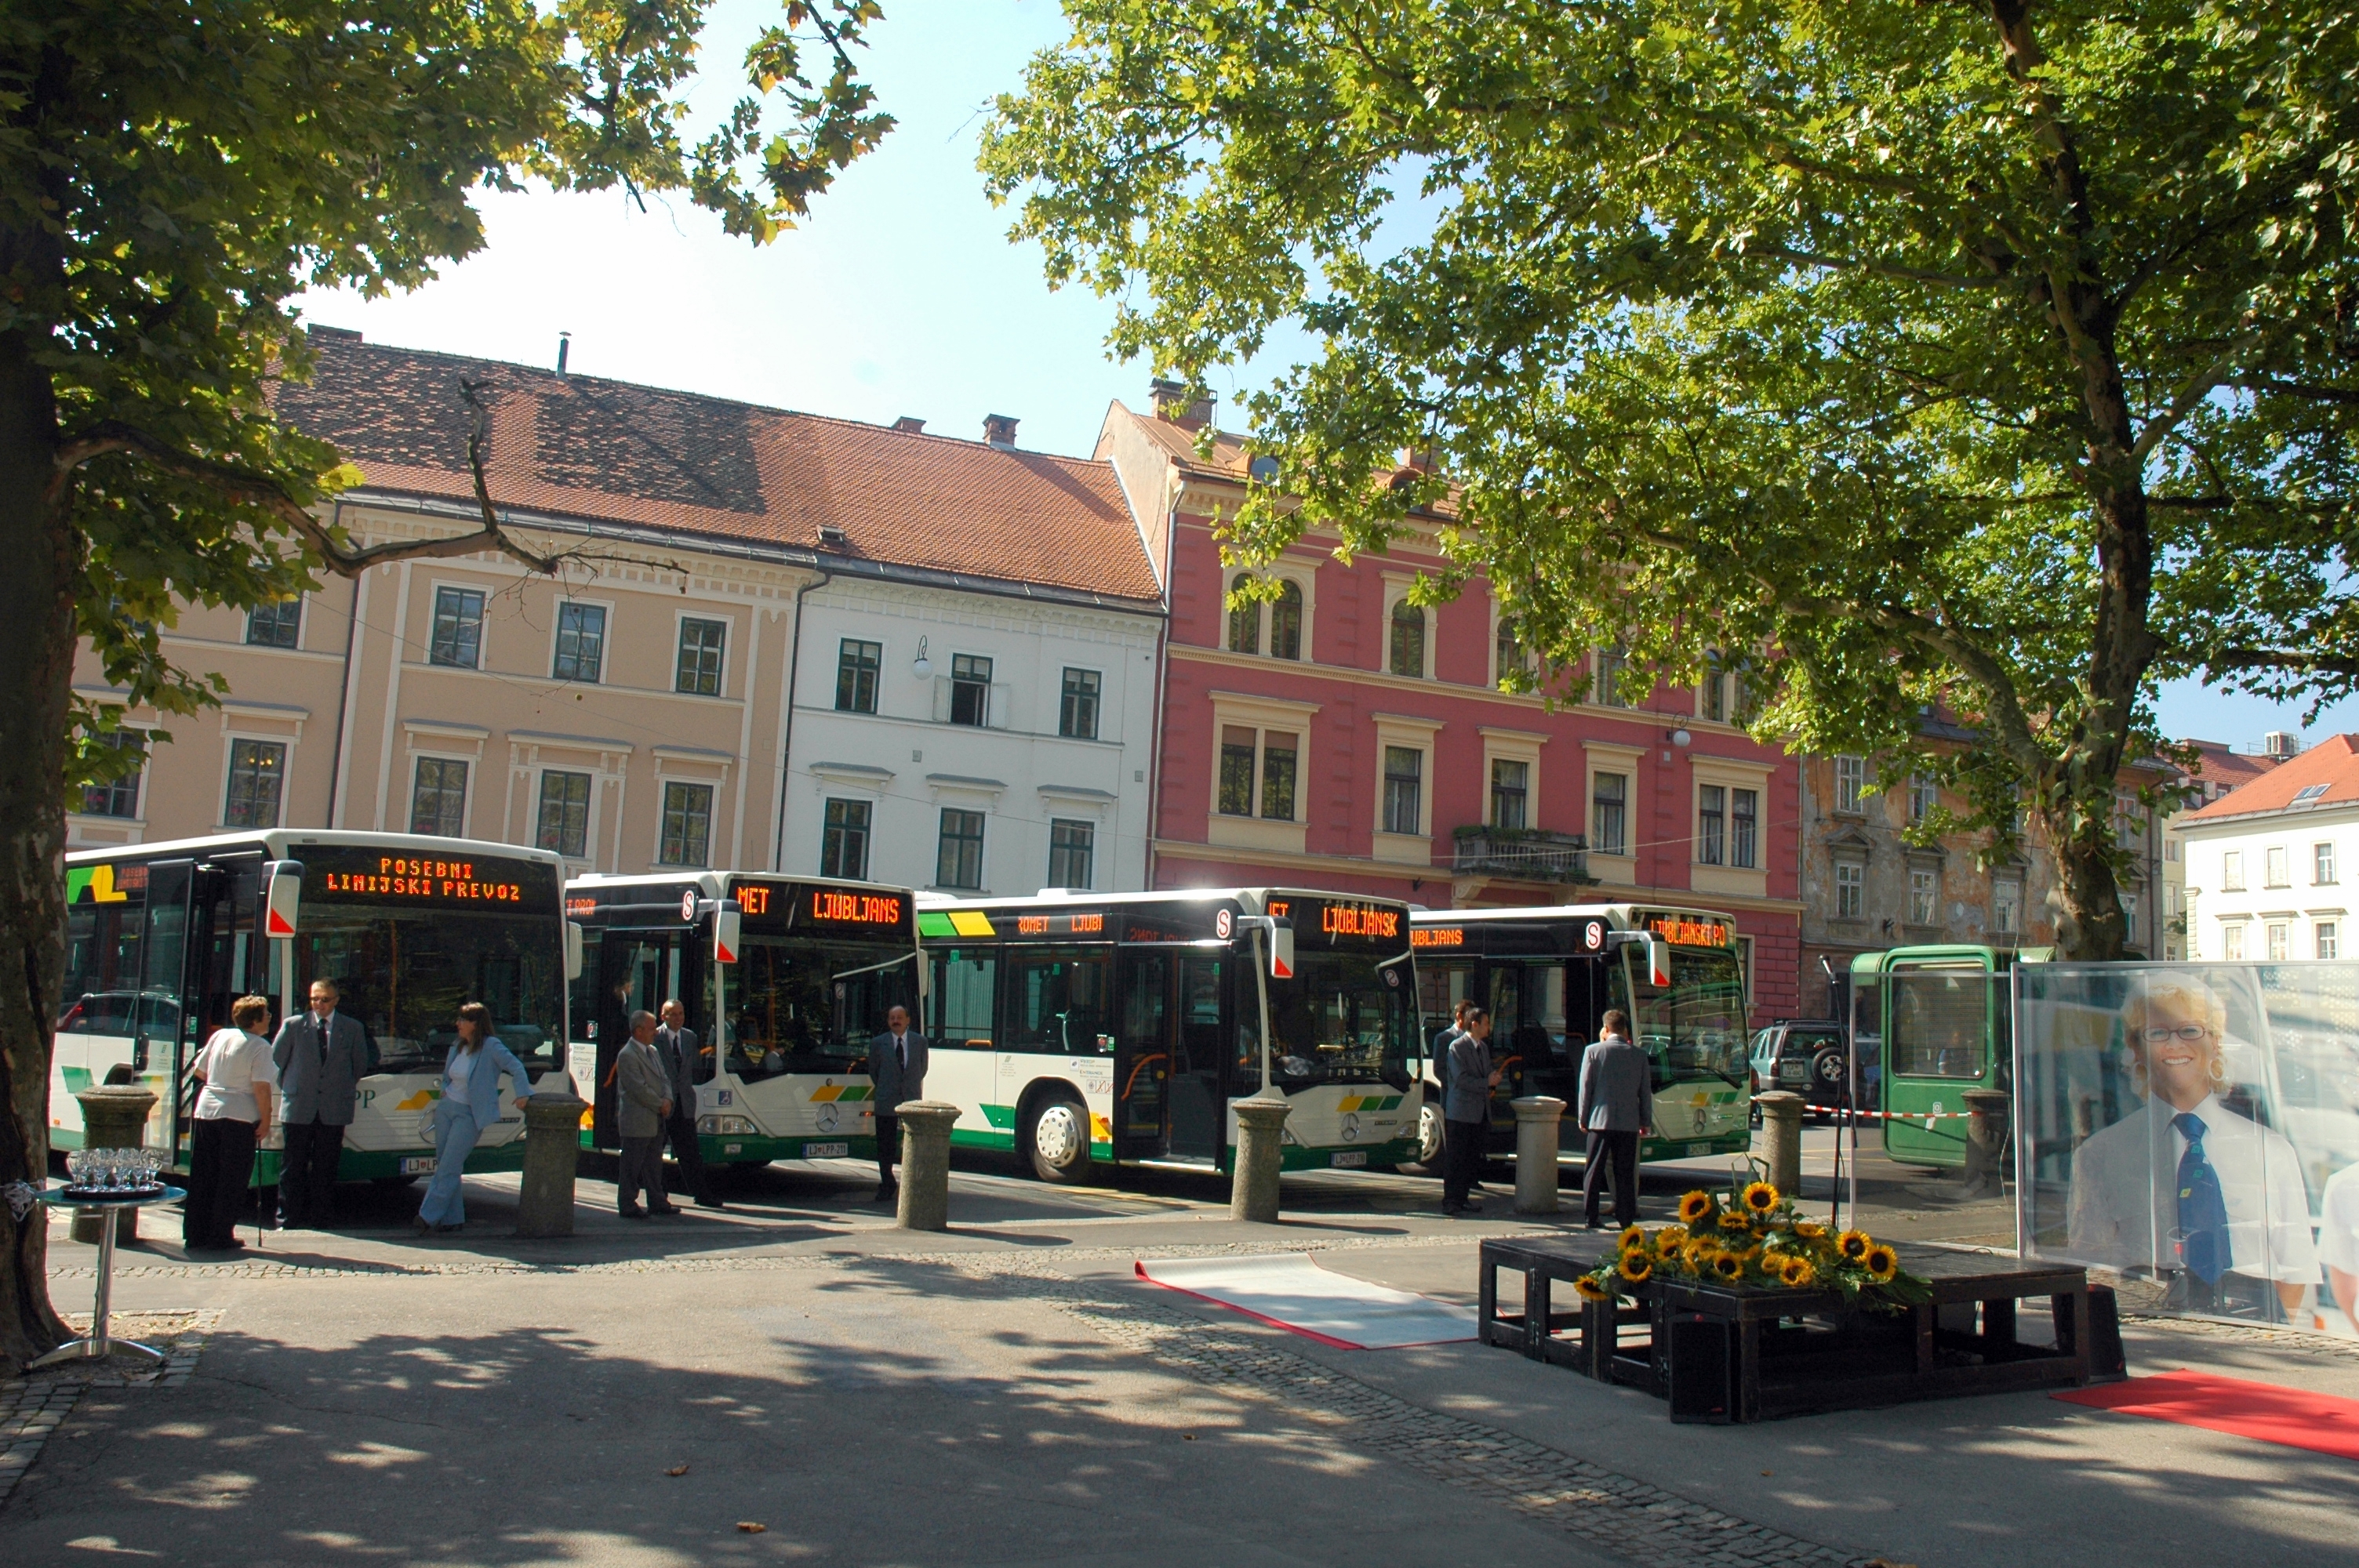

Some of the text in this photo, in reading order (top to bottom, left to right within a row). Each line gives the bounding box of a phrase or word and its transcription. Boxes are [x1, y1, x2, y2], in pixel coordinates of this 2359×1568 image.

[381, 858, 471, 879] POSEBNI
[328, 873, 431, 895] LINIJSKI
[738, 887, 900, 923] MET LJUBLJANS
[1323, 907, 1398, 936] LJUBLJANSK
[1714, 925, 1725, 947] PO
